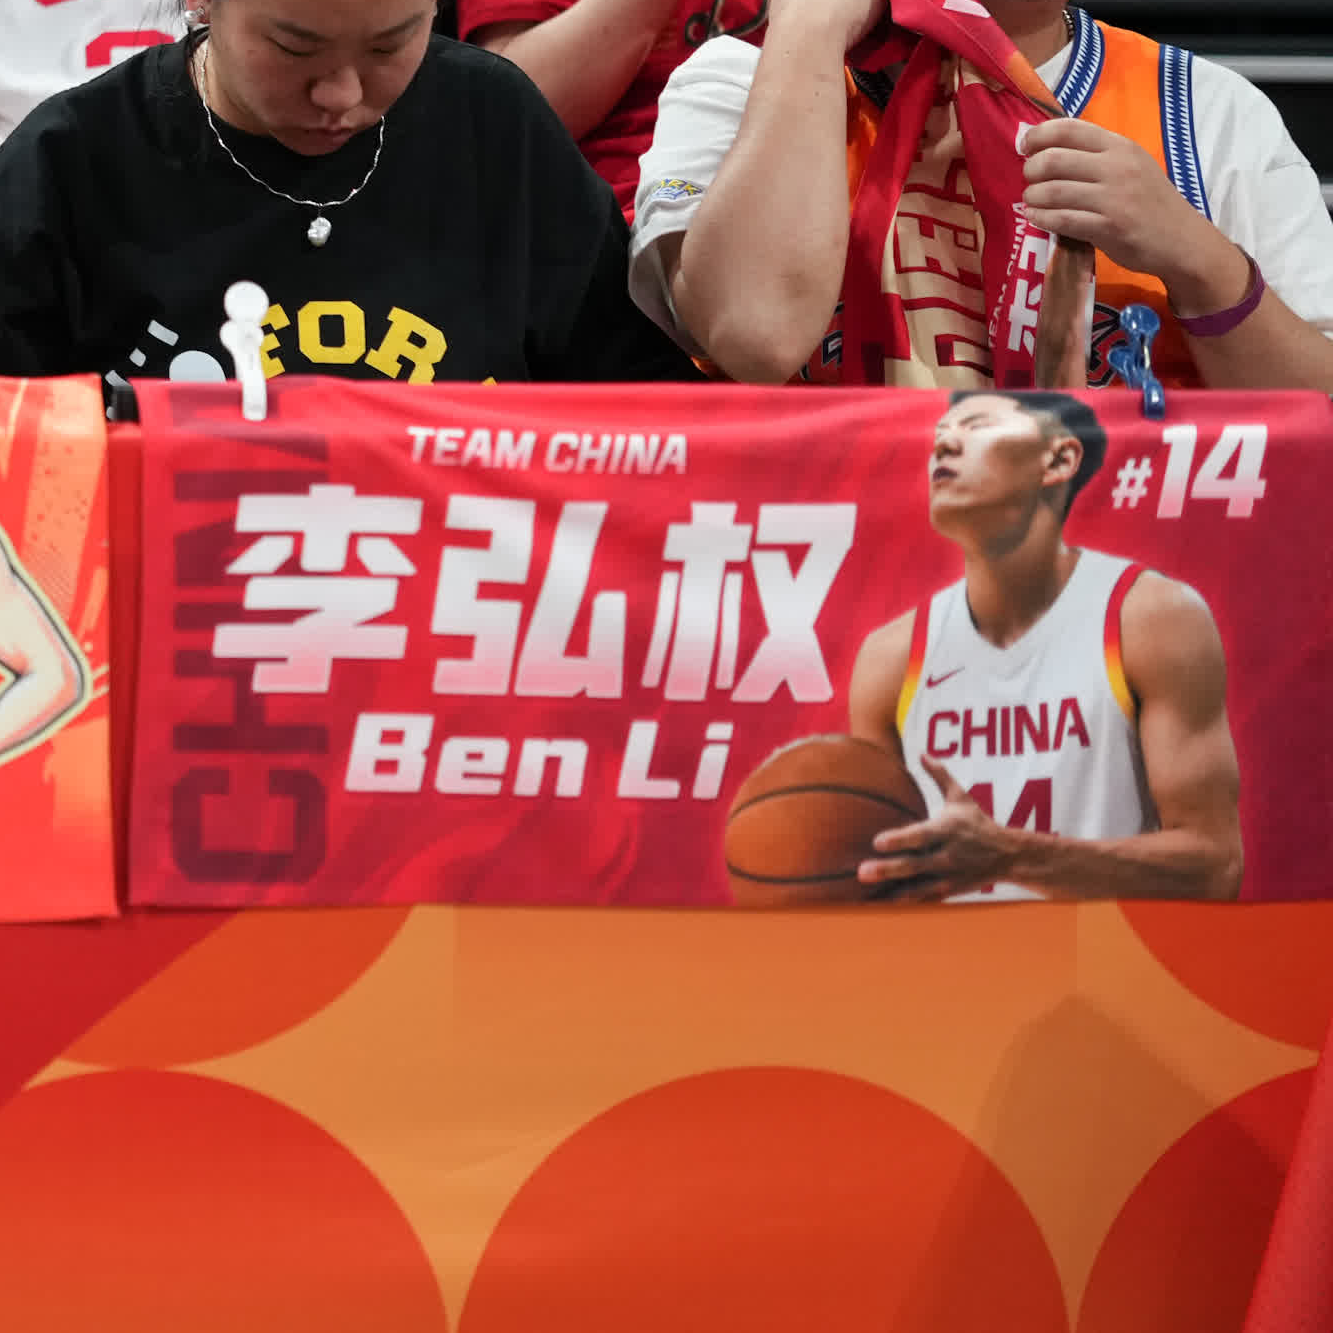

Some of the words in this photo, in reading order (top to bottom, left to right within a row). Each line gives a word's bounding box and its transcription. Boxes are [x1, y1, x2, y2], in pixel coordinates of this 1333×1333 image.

[407, 426, 537, 471] TEAM
[544, 432, 688, 475] CHINA
[1111, 423, 1268, 518] #14
[213, 484, 857, 703] 李弘权
[344, 713, 588, 798] Ben
[617, 720, 734, 800] Li
[926, 696, 1091, 759] CHINA
